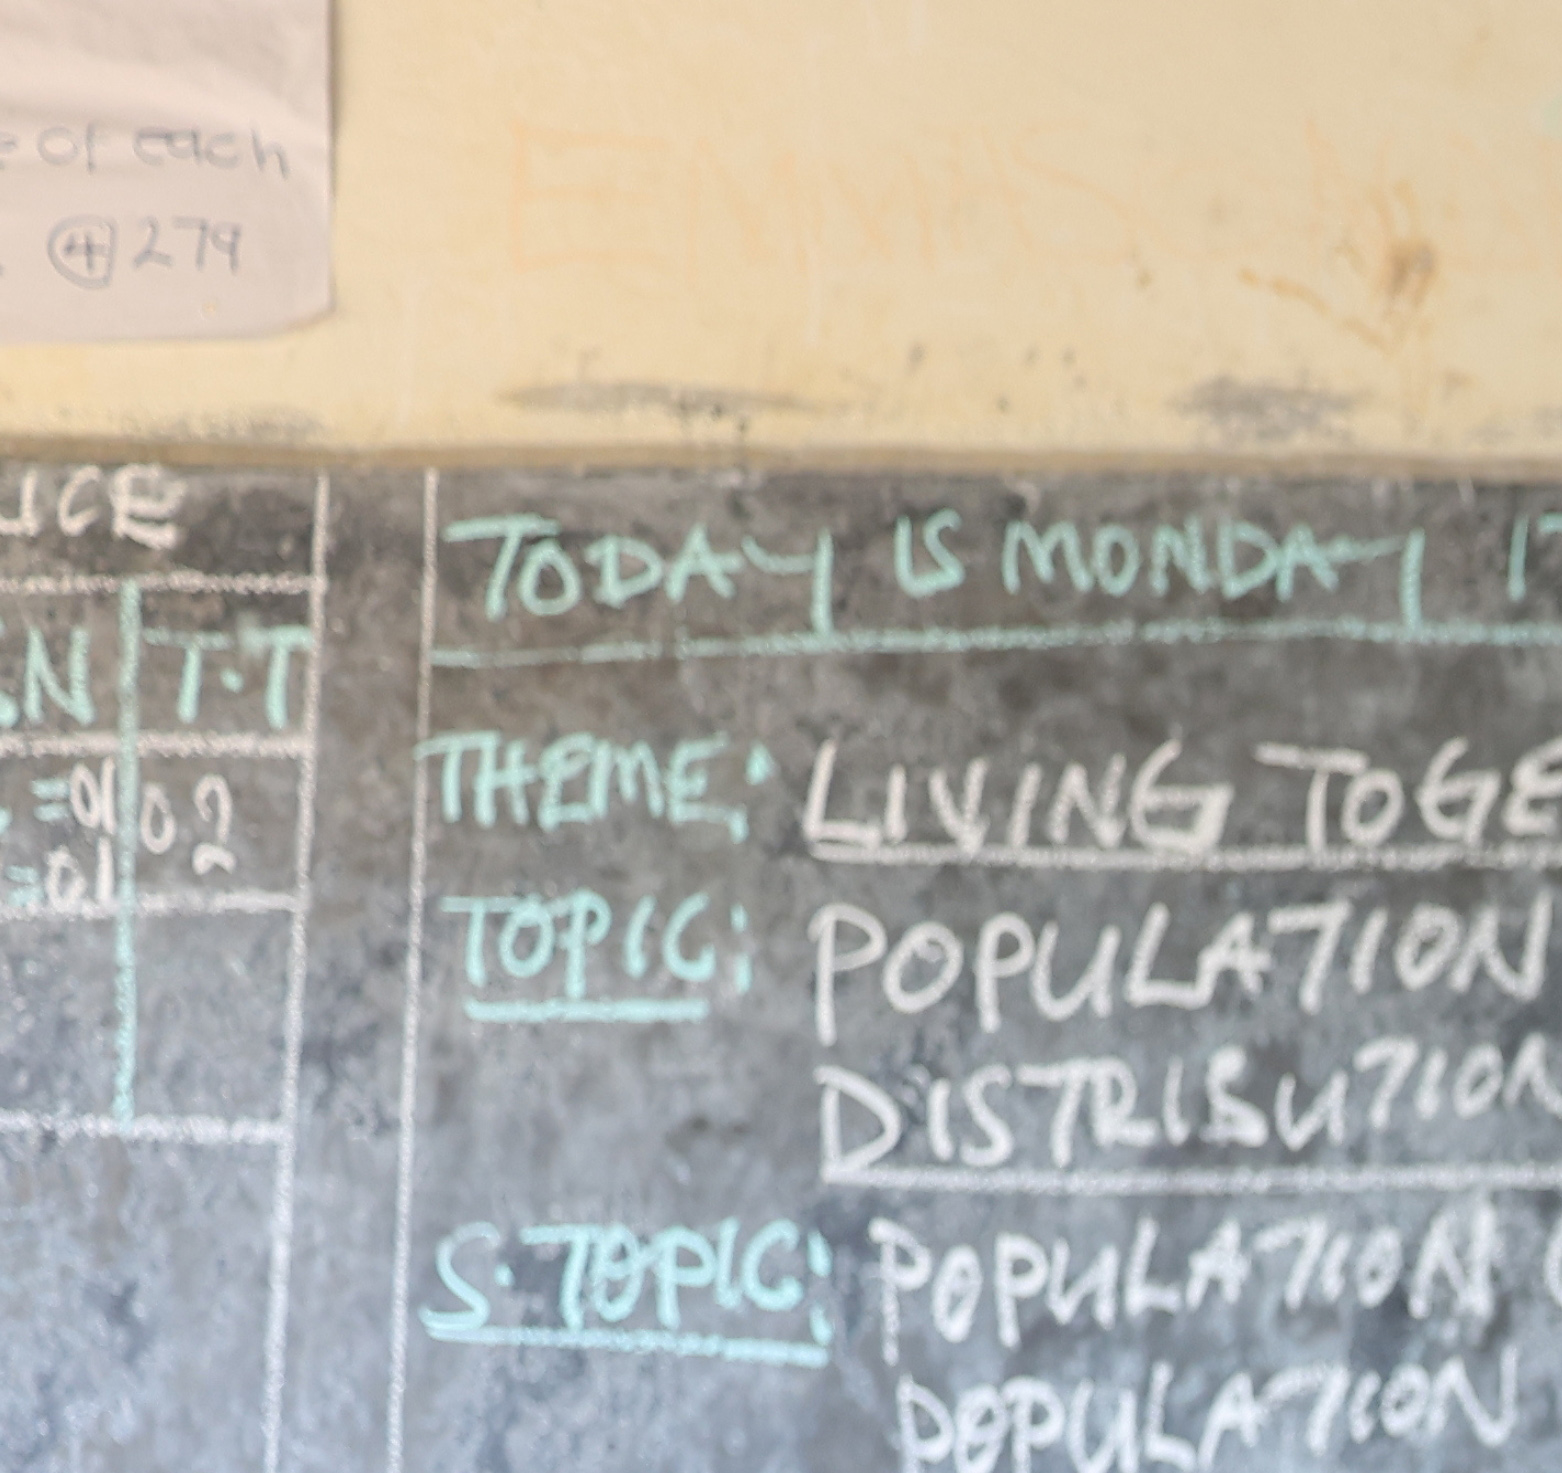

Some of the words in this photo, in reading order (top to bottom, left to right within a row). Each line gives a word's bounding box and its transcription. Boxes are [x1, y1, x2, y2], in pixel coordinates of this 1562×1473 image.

[442, 512, 832, 636] TODAY
[895, 508, 965, 598] IS
[1002, 513, 1426, 632] MONDAY
[803, 735, 1234, 858] LIVING
[808, 886, 1556, 1047] POPULATION
[868, 1202, 1506, 1370] POPULATION
